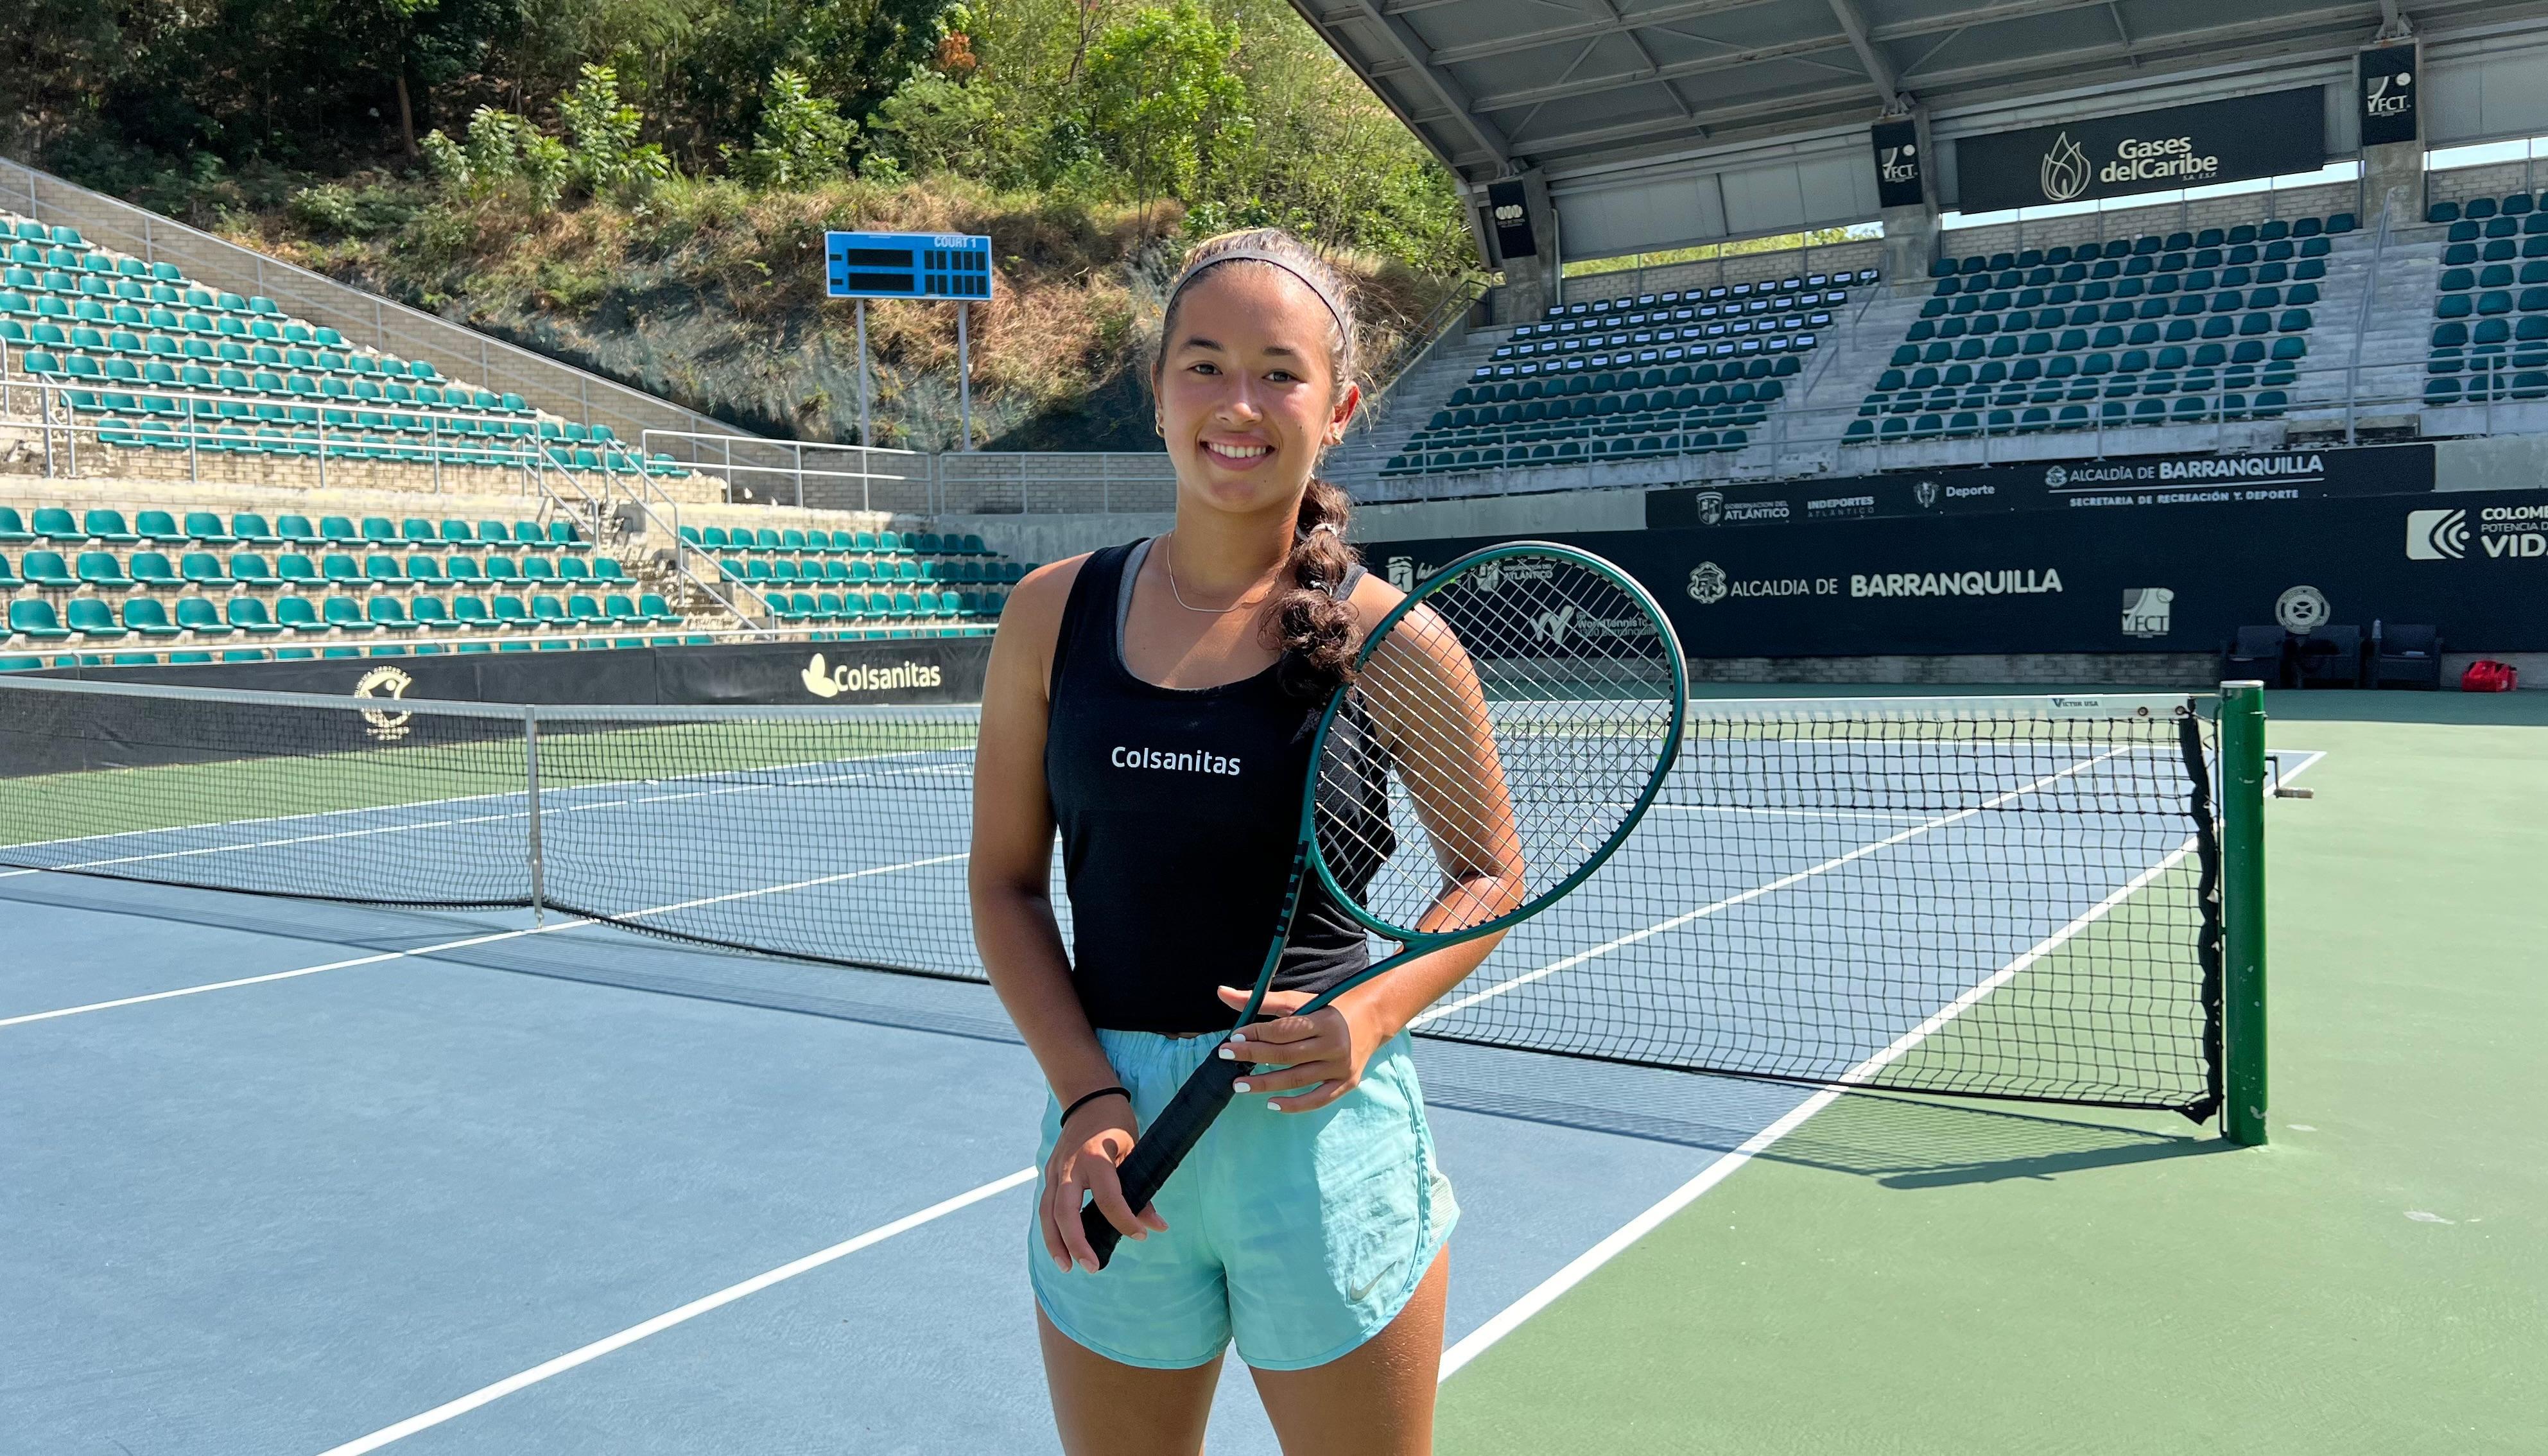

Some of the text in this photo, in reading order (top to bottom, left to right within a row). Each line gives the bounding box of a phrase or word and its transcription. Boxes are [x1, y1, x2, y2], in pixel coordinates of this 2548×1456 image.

[2118, 136, 2192, 159] Gases
[2100, 153, 2218, 183] delCaribe
[934, 236, 976, 248] COURT 1
[2137, 466, 2155, 480] DE
[2159, 455, 2325, 480] BARRANQUILLA
[1807, 496, 1874, 509] INDEPORTES
[1946, 485, 1995, 498] Deporte
[2070, 496, 2134, 507] SECRETARIA
[2138, 495, 2152, 505] DE
[2246, 489, 2298, 500] DEPORTE
[2481, 521, 2538, 533] POTENCIA
[1730, 568, 2063, 597] ALCALDIA DE BARRANQUILLA
[835, 661, 941, 691] Colsanitas
[1111, 747, 1240, 776] Colsanitas
